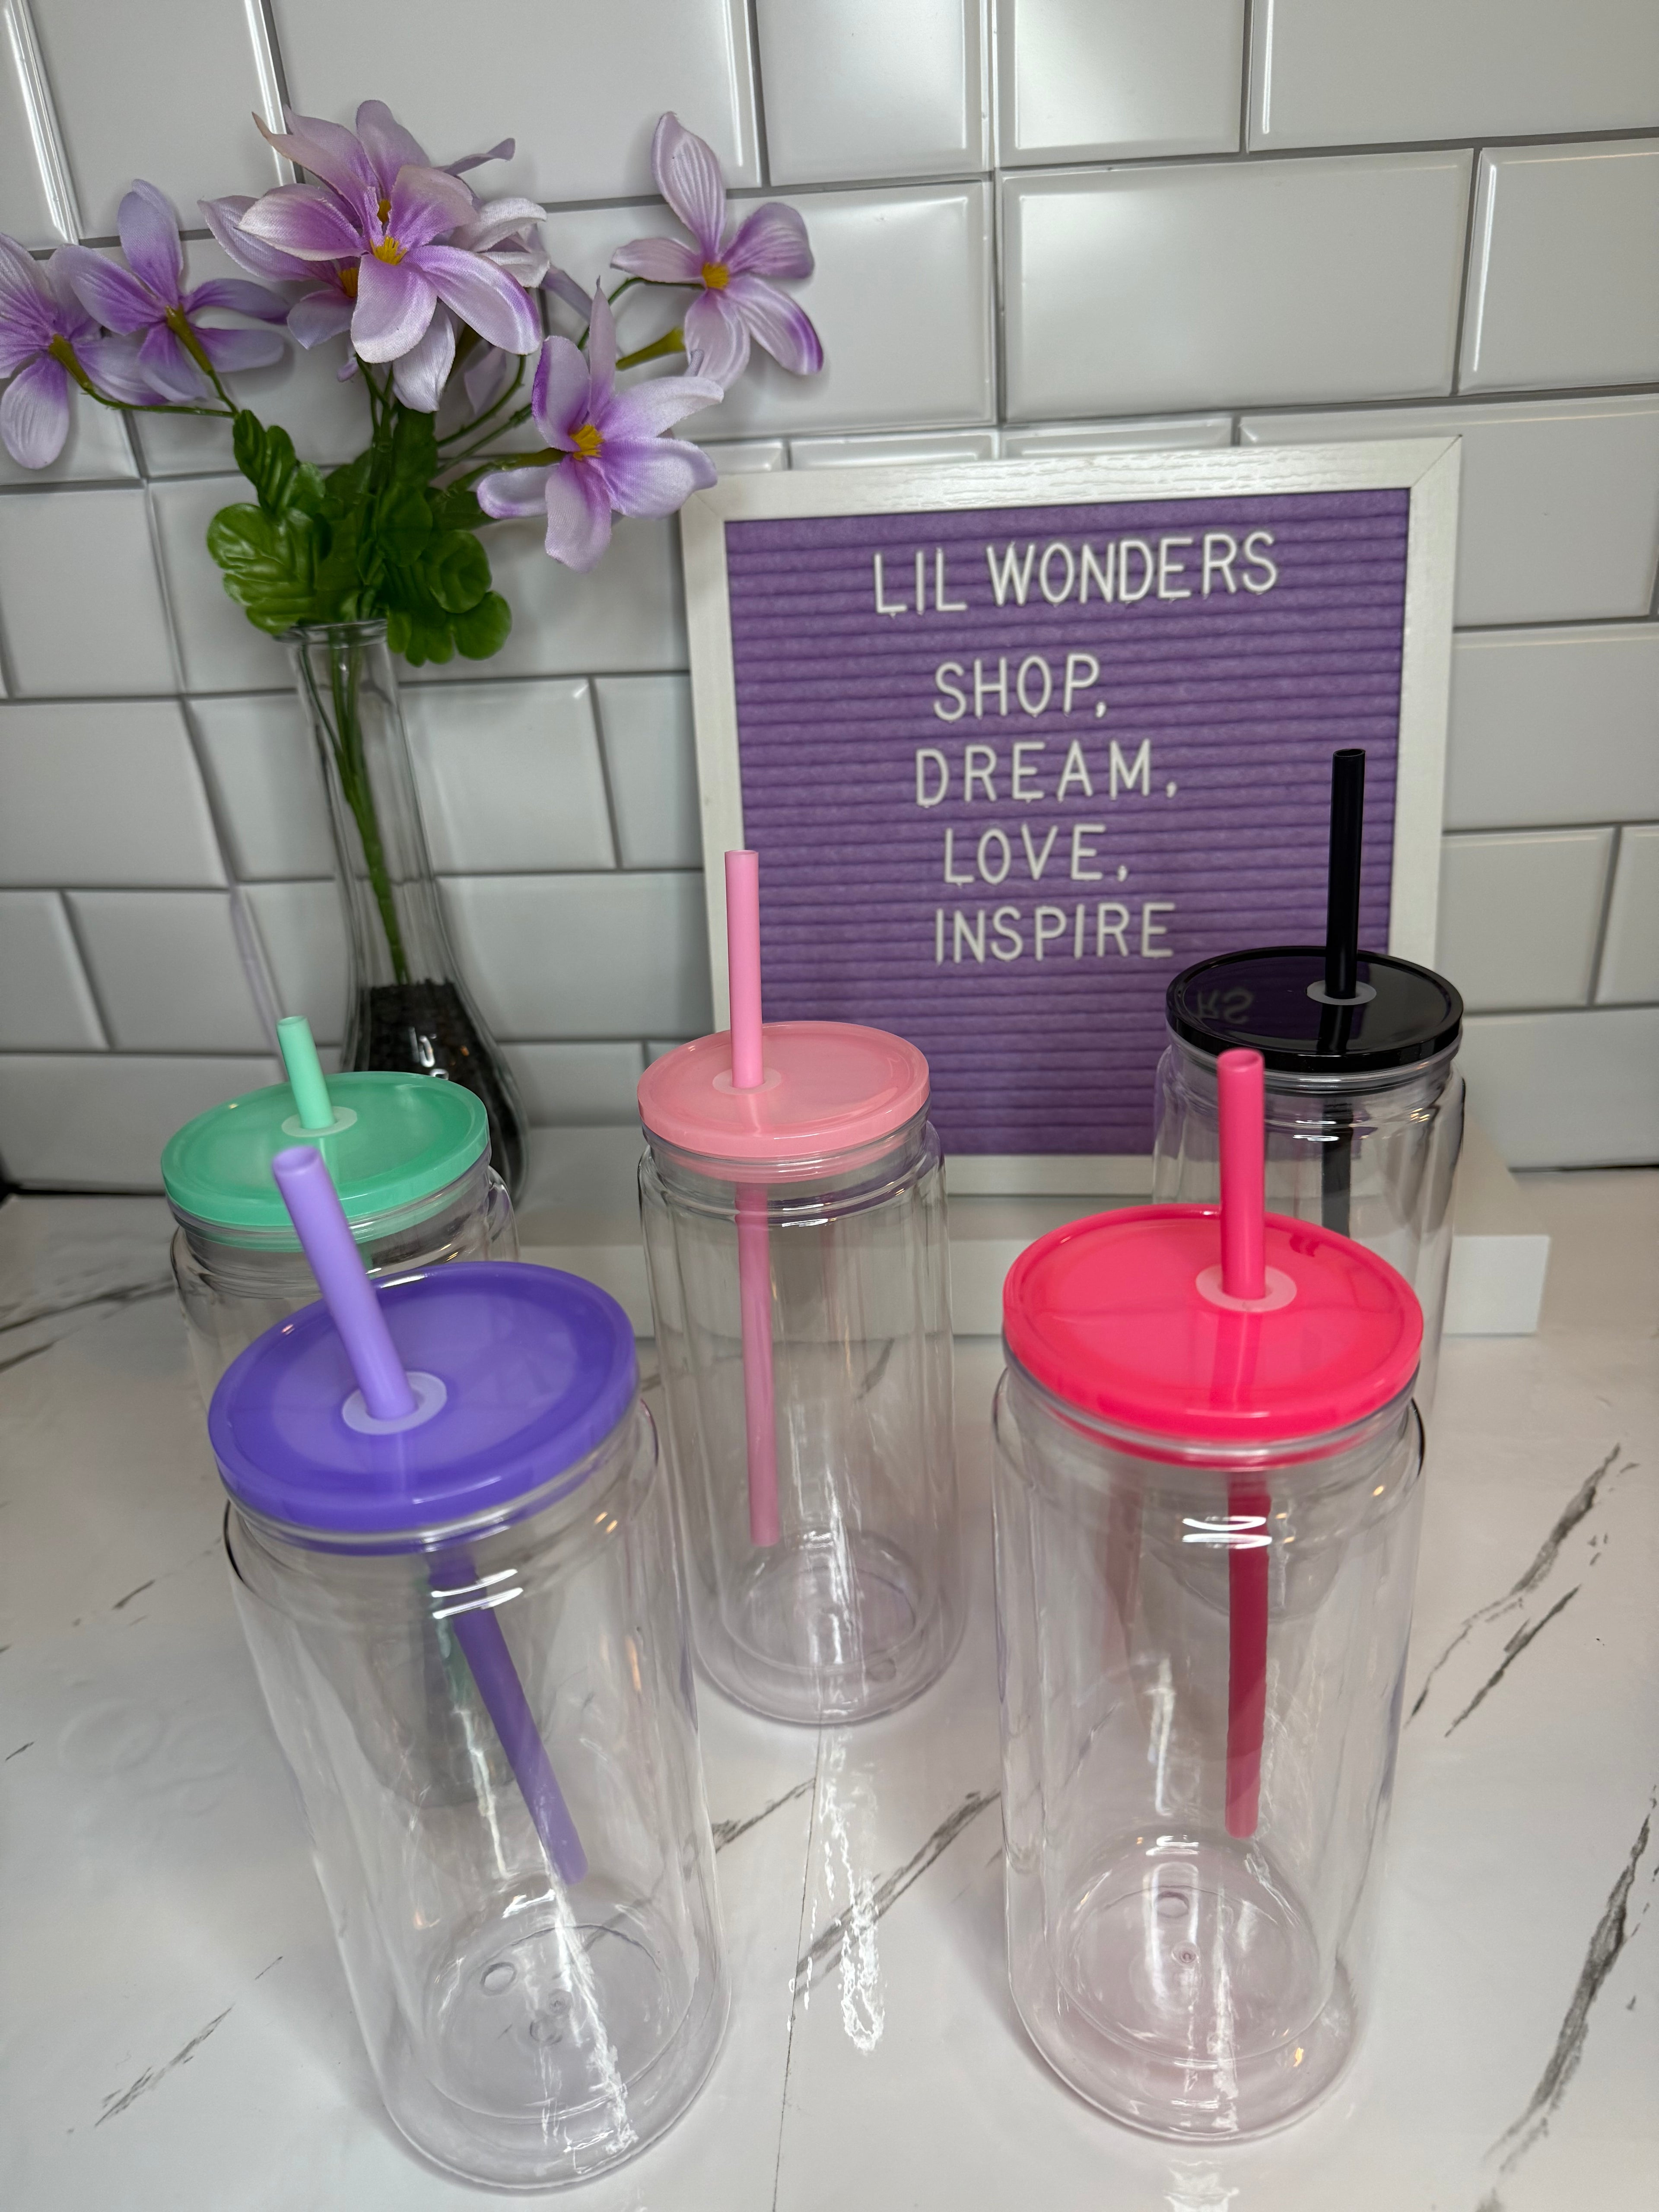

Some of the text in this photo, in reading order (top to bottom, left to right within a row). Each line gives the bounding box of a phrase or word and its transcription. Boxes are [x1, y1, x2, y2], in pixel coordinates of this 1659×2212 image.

[874, 531, 1278, 616] LIL WONDERS
[934, 653, 1107, 722] SHOP,
[915, 738, 1177, 808] DREAM,
[944, 823, 1128, 886] LOVE,
[935, 903, 1176, 966] INSPIRE
